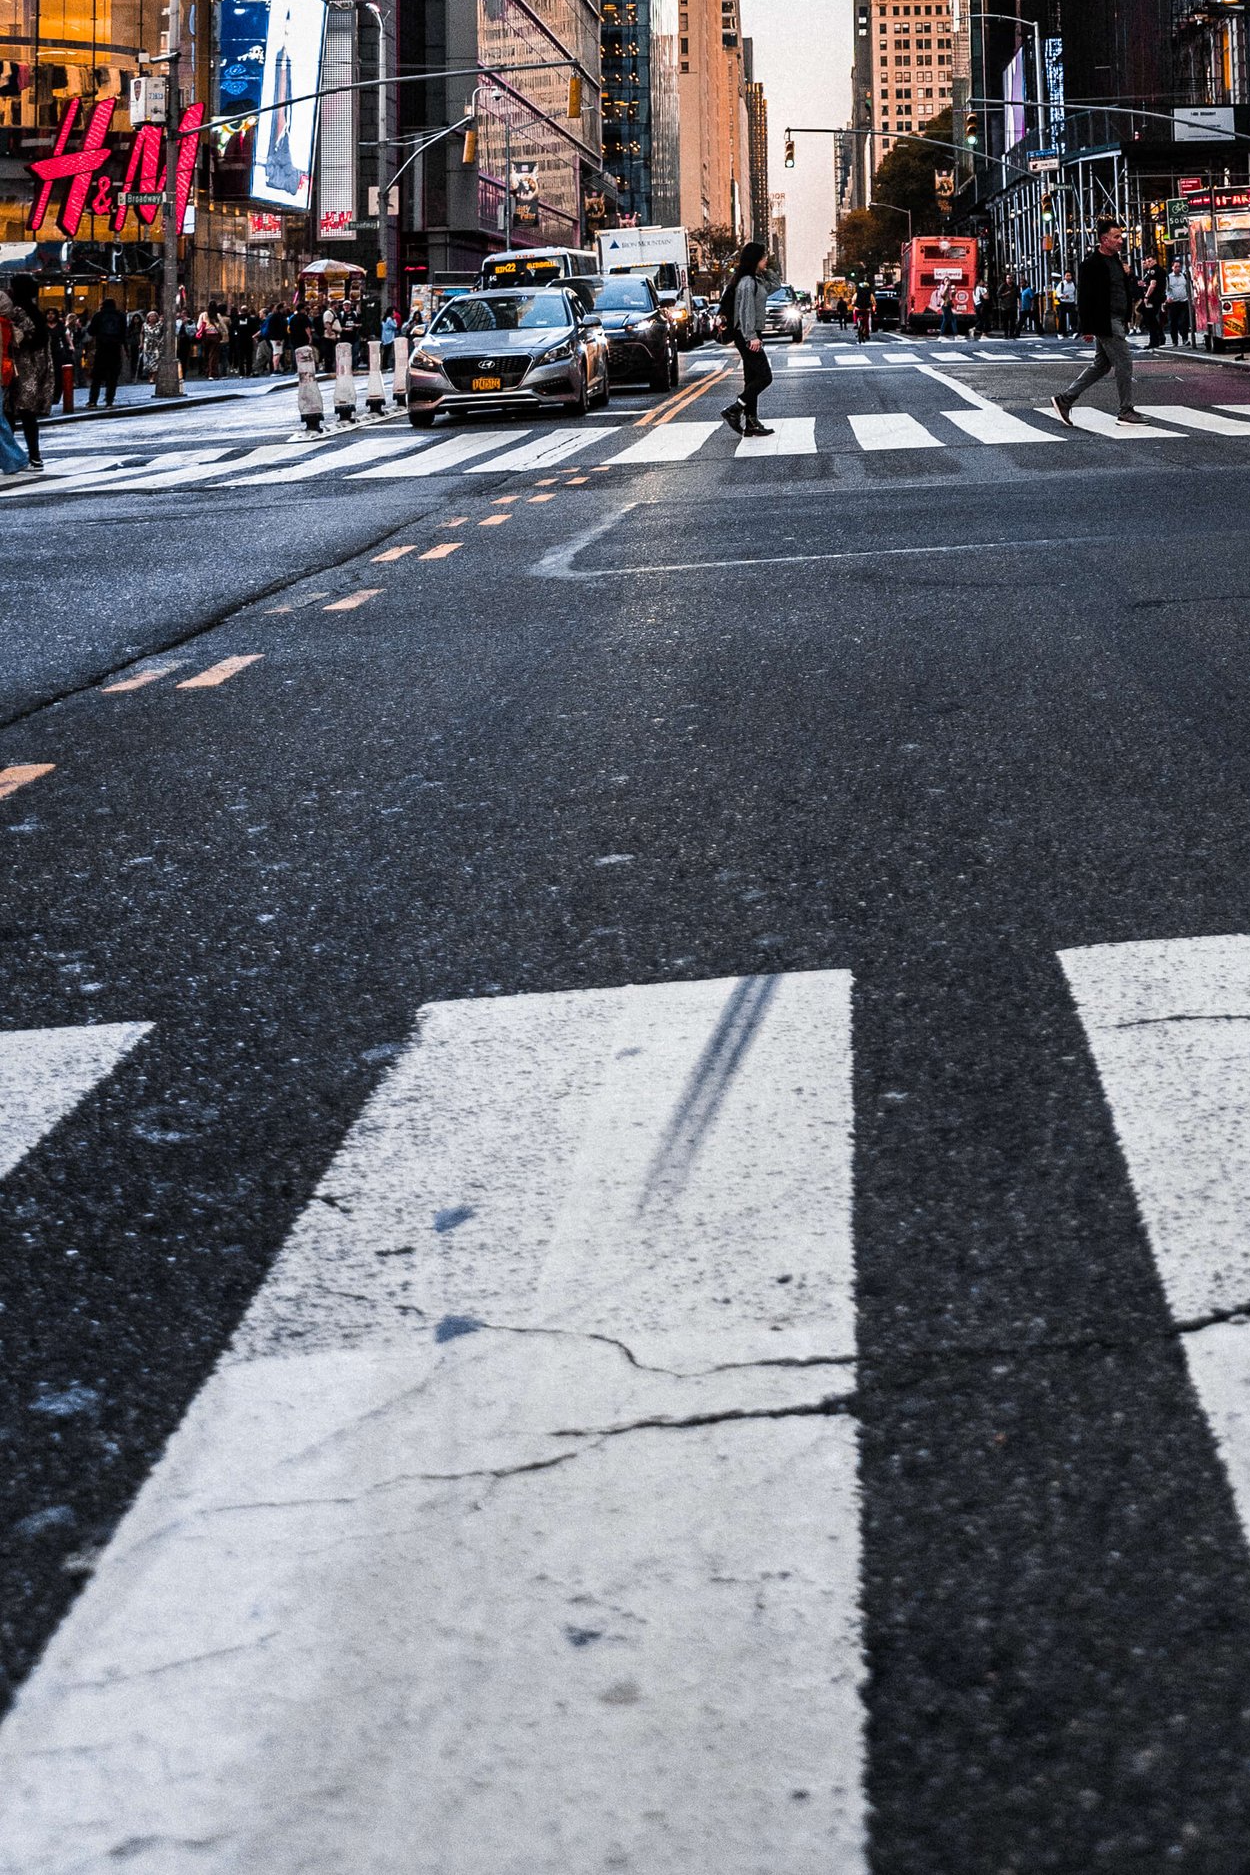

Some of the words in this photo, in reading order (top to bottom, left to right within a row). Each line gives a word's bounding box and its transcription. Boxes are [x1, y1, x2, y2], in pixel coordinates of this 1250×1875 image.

[28, 96, 205, 237] H&M
[127, 193, 161, 203] Broadway
[638, 239, 671, 247] MOUNTAIN
